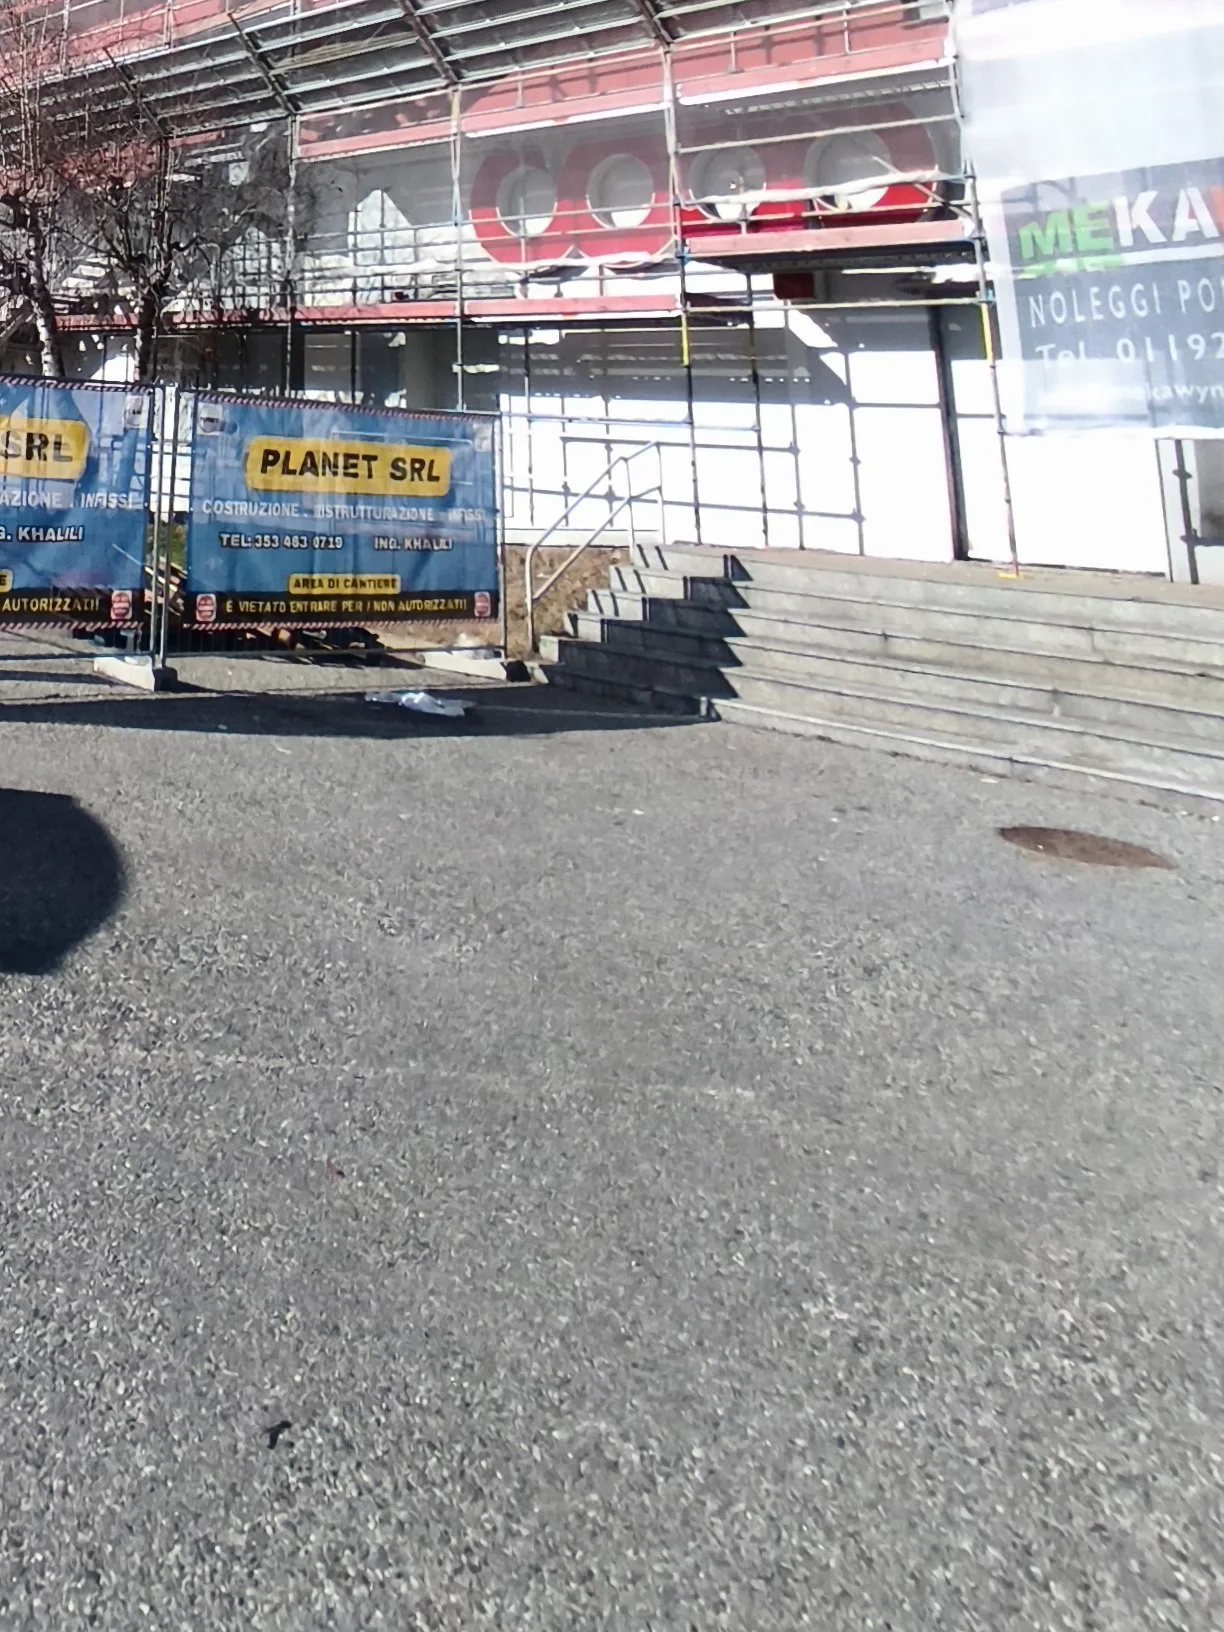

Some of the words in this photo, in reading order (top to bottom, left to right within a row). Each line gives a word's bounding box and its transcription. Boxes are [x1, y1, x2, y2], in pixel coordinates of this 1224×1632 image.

[1028, 282, 1162, 329] NOLEGGI
[0, 429, 74, 463] SRL
[259, 447, 378, 480] PLANET
[389, 455, 441, 482] SRL
[202, 500, 300, 518] COSTRUZIONE
[18, 526, 85, 542] KHALILI
[220, 533, 252, 548] TEL:
[254, 534, 279, 548] 353
[313, 536, 343, 549] 0719
[293, 578, 325, 589] AREA
[327, 578, 340, 589] DI
[343, 578, 398, 590] CANTIERE
[238, 600, 287, 614] VIETATO
[289, 599, 337, 613] ENTRARE
[341, 599, 363, 612] PER
[373, 599, 396, 613] NON
